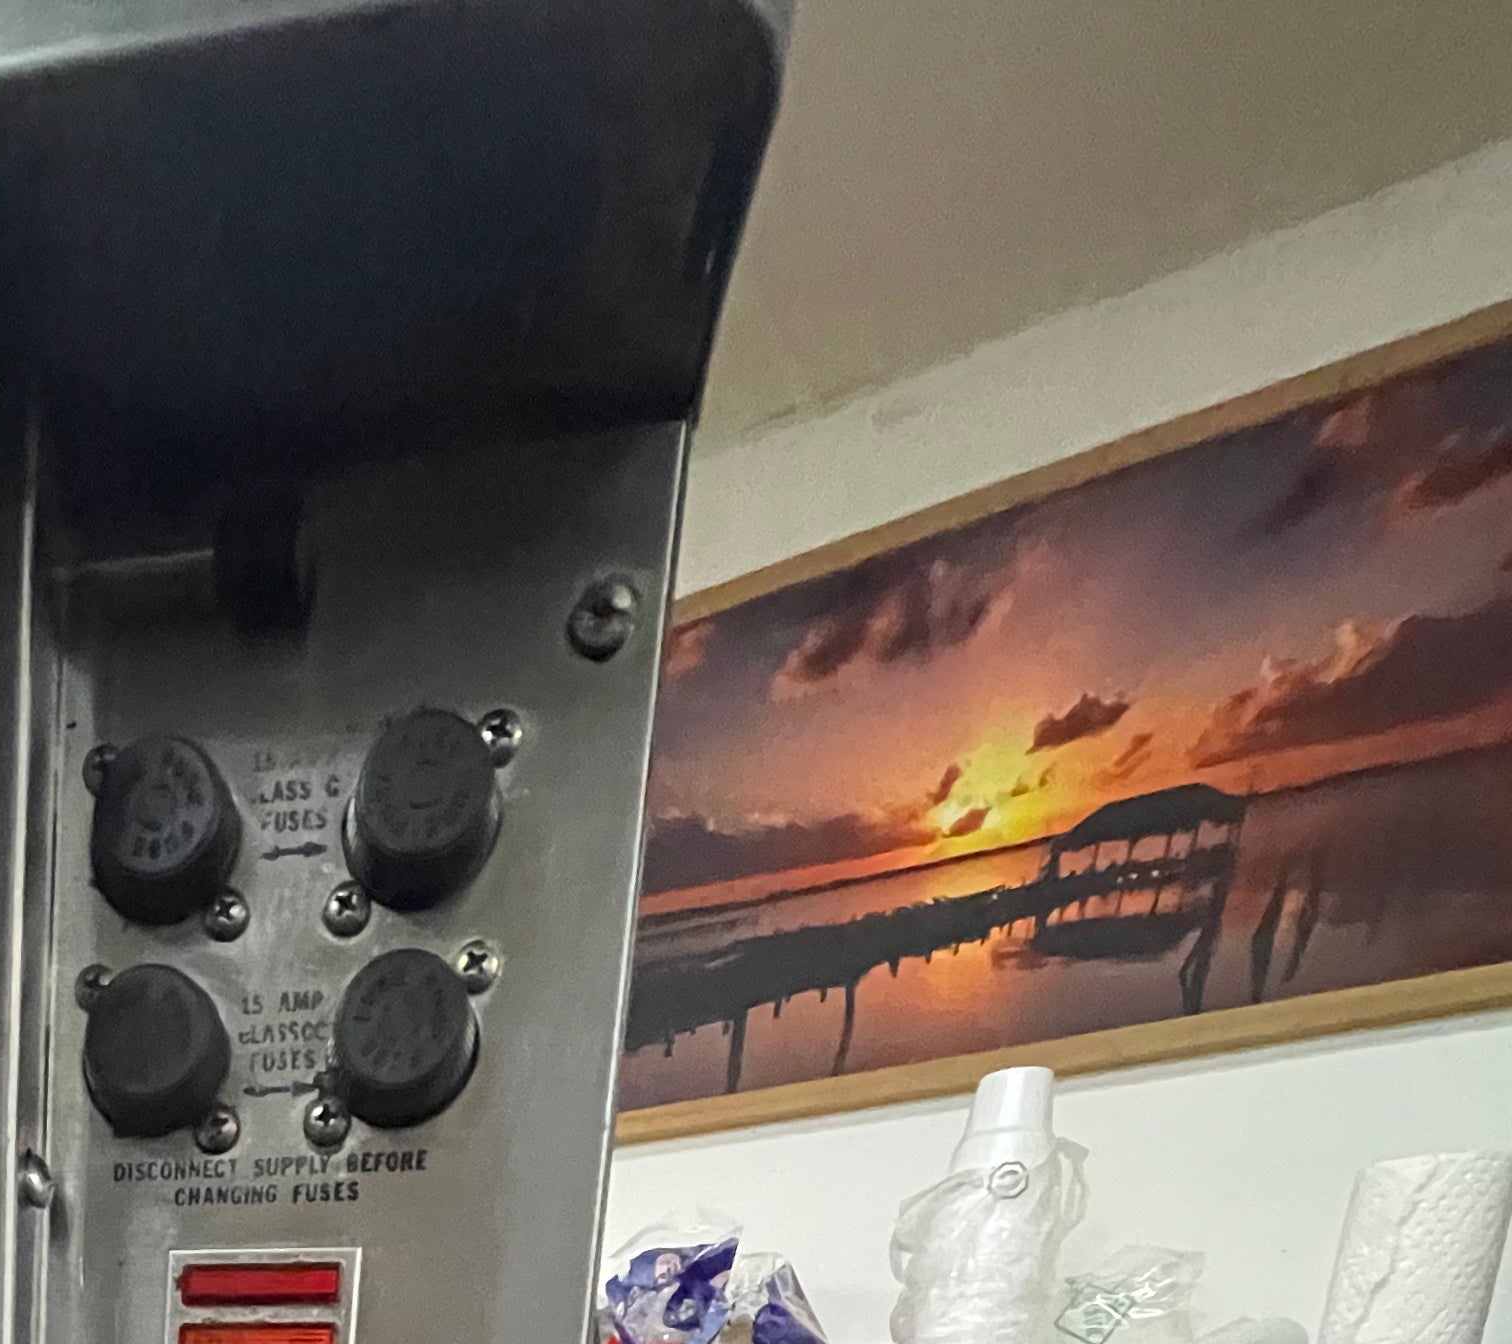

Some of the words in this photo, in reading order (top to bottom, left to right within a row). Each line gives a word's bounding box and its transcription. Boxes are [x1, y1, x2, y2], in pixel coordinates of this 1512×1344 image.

[277, 989, 323, 1012] AMP
[248, 1047, 315, 1072] FUSES
[113, 1157, 237, 1182] DISCONNECT
[253, 1155, 330, 1178] SUPPLY
[346, 1150, 428, 1173] BEFORE
[174, 1184, 278, 1206] CHANGING
[292, 1181, 360, 1204] FUSES
